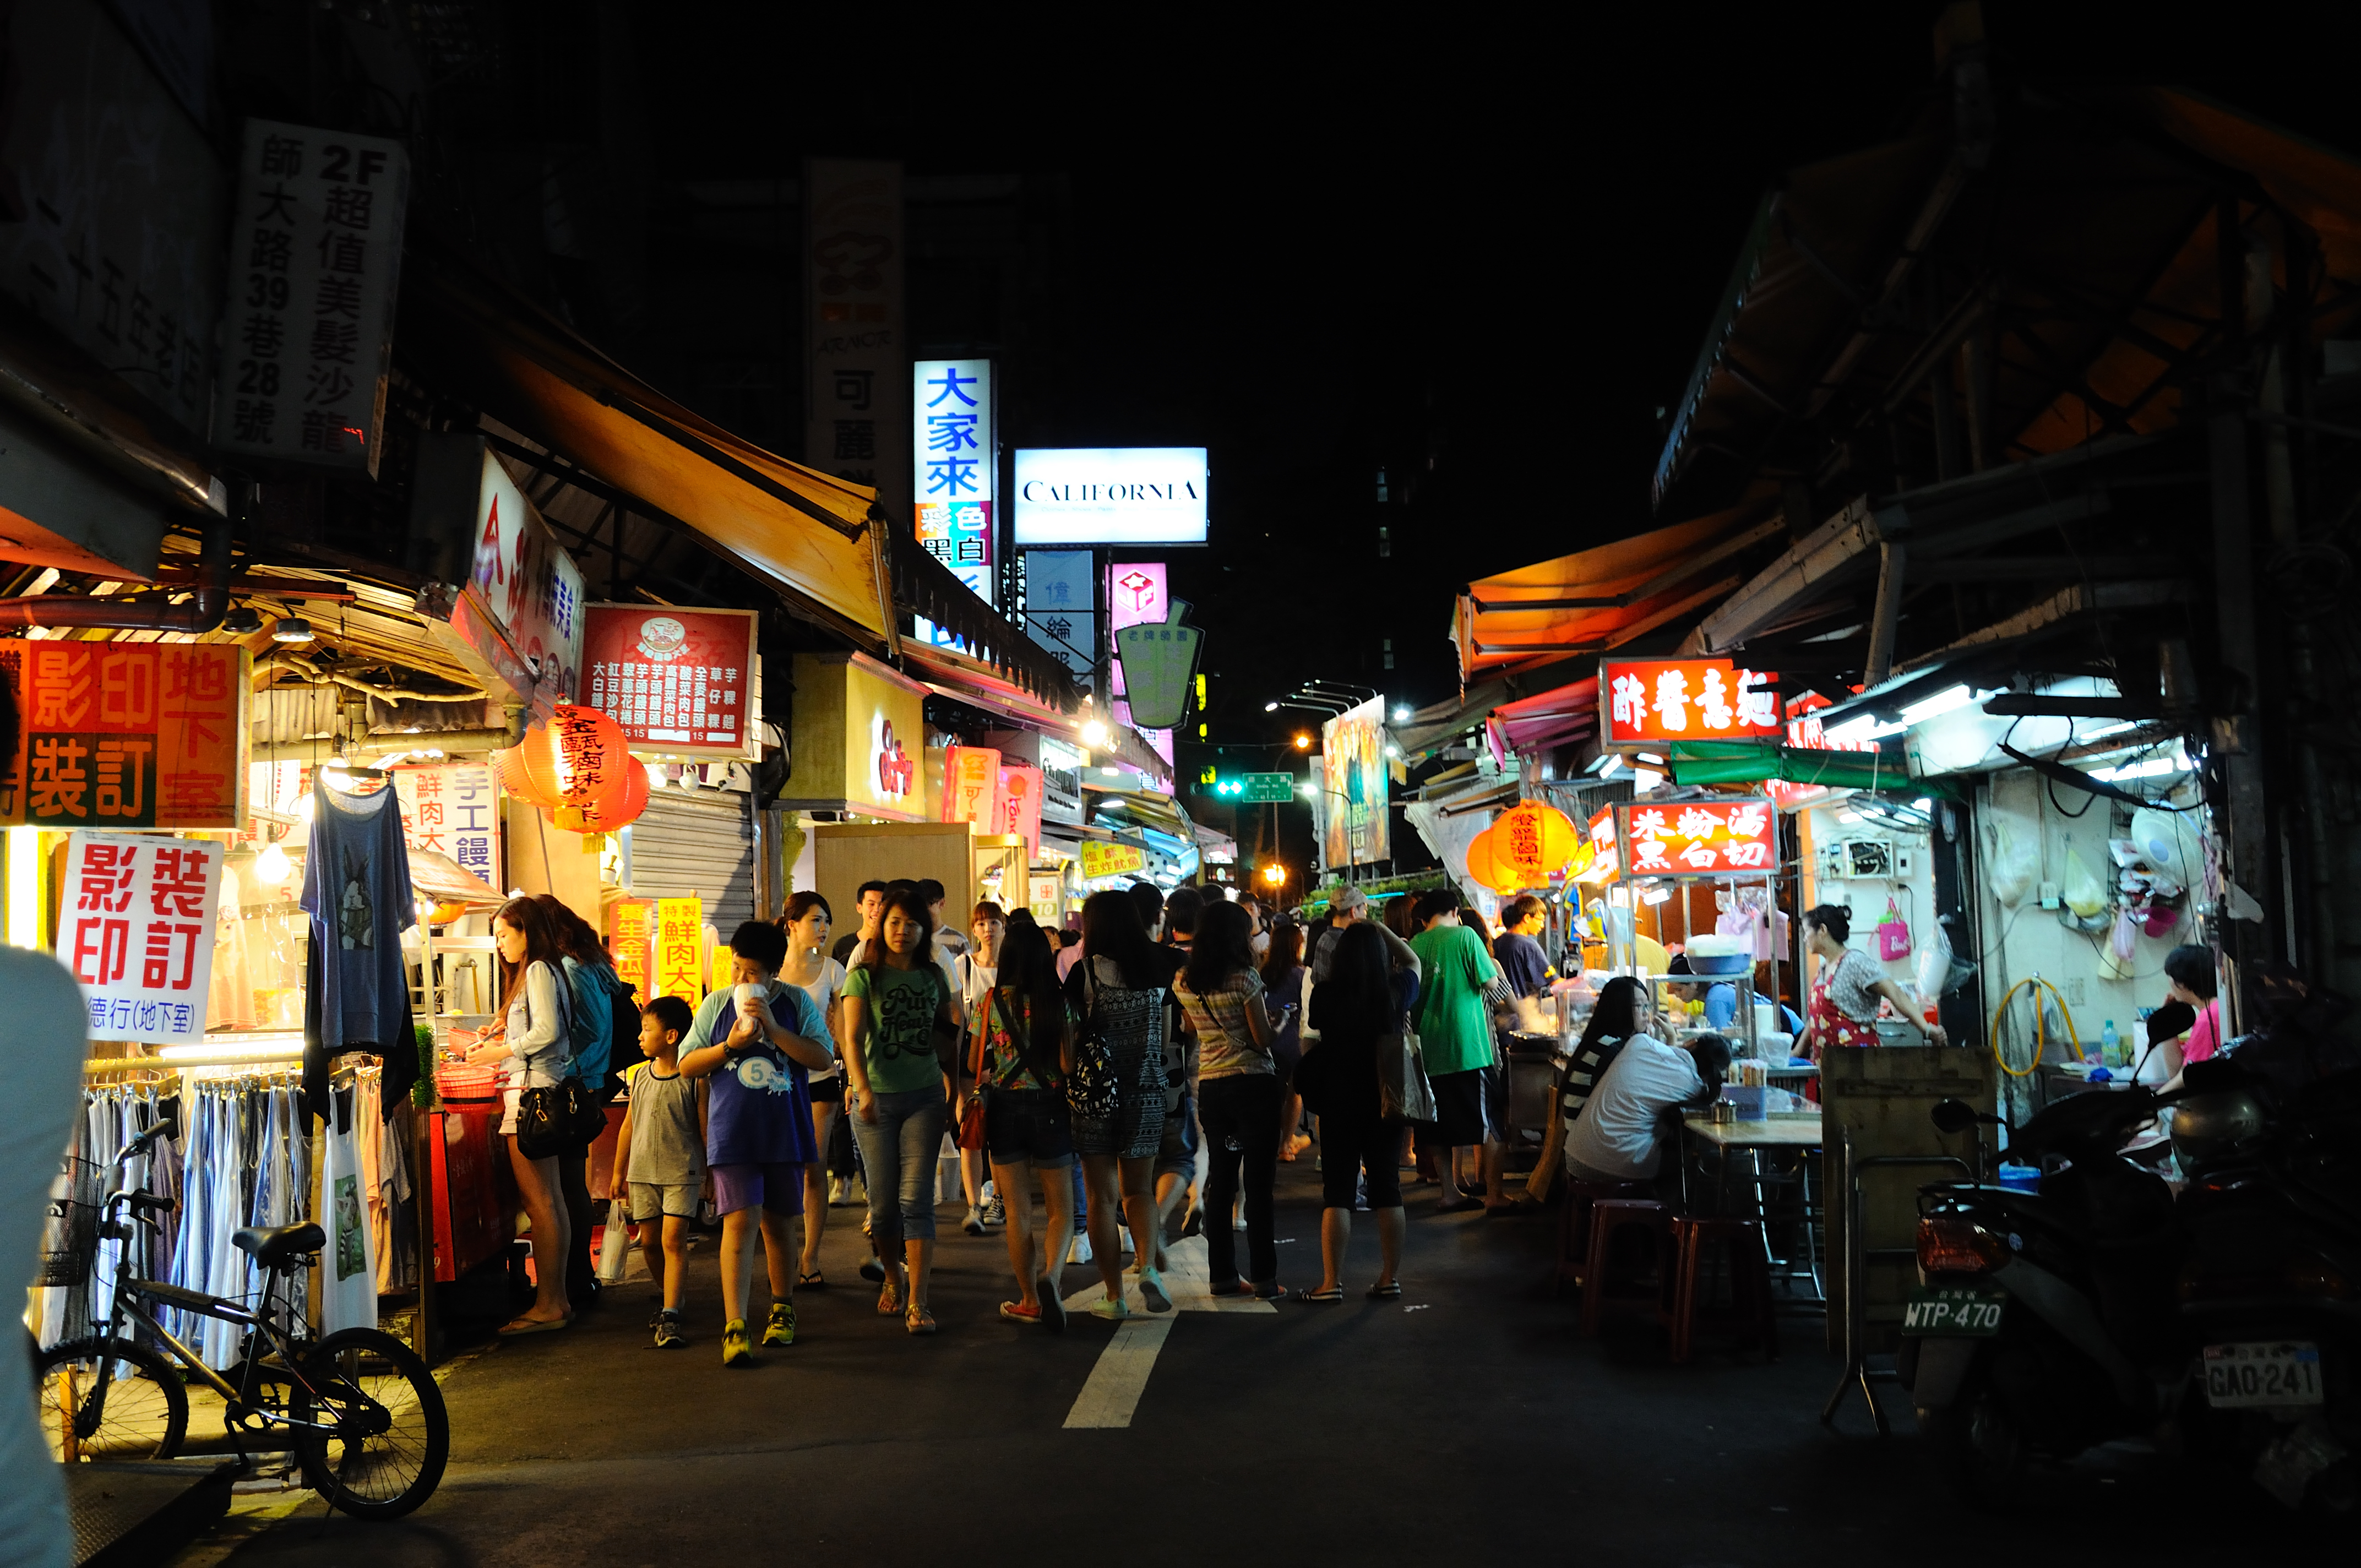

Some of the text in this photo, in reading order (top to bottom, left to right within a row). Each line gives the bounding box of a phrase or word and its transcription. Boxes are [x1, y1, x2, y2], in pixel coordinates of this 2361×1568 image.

[320, 145, 387, 184] 2F
[233, 134, 303, 444] 師大路39巷28號
[302, 186, 372, 455] 超值美髮沙龍
[926, 368, 978, 496] 大家來
[921, 505, 987, 532] 彩色
[1024, 480, 1198, 502] CALIFORNIA
[923, 537, 985, 562] 黑白
[34, 651, 154, 728] 影印
[591, 661, 605, 711] 大白饅
[606, 662, 620, 723] 紅豆沙包
[634, 663, 649, 726] 芋頭饅頭
[648, 663, 663, 726] 芋頭饅頭
[662, 665, 678, 727] 高麗菜肉包
[678, 665, 692, 727] 酸菜肉包
[692, 666, 707, 728] 全麥饅頭
[707, 667, 722, 728] 草仔粿
[164, 651, 227, 819] 地下室
[634, 729, 645, 738] 15
[693, 732, 704, 741] 15
[29, 738, 152, 818] 裝訂
[1629, 805, 1766, 841] 米粉湯
[1632, 839, 1766, 872] 黑白切
[73, 844, 138, 986] 影印
[143, 848, 209, 990] 裝訂
[664, 905, 696, 917] 特製
[750, 1063, 764, 1082] 5
